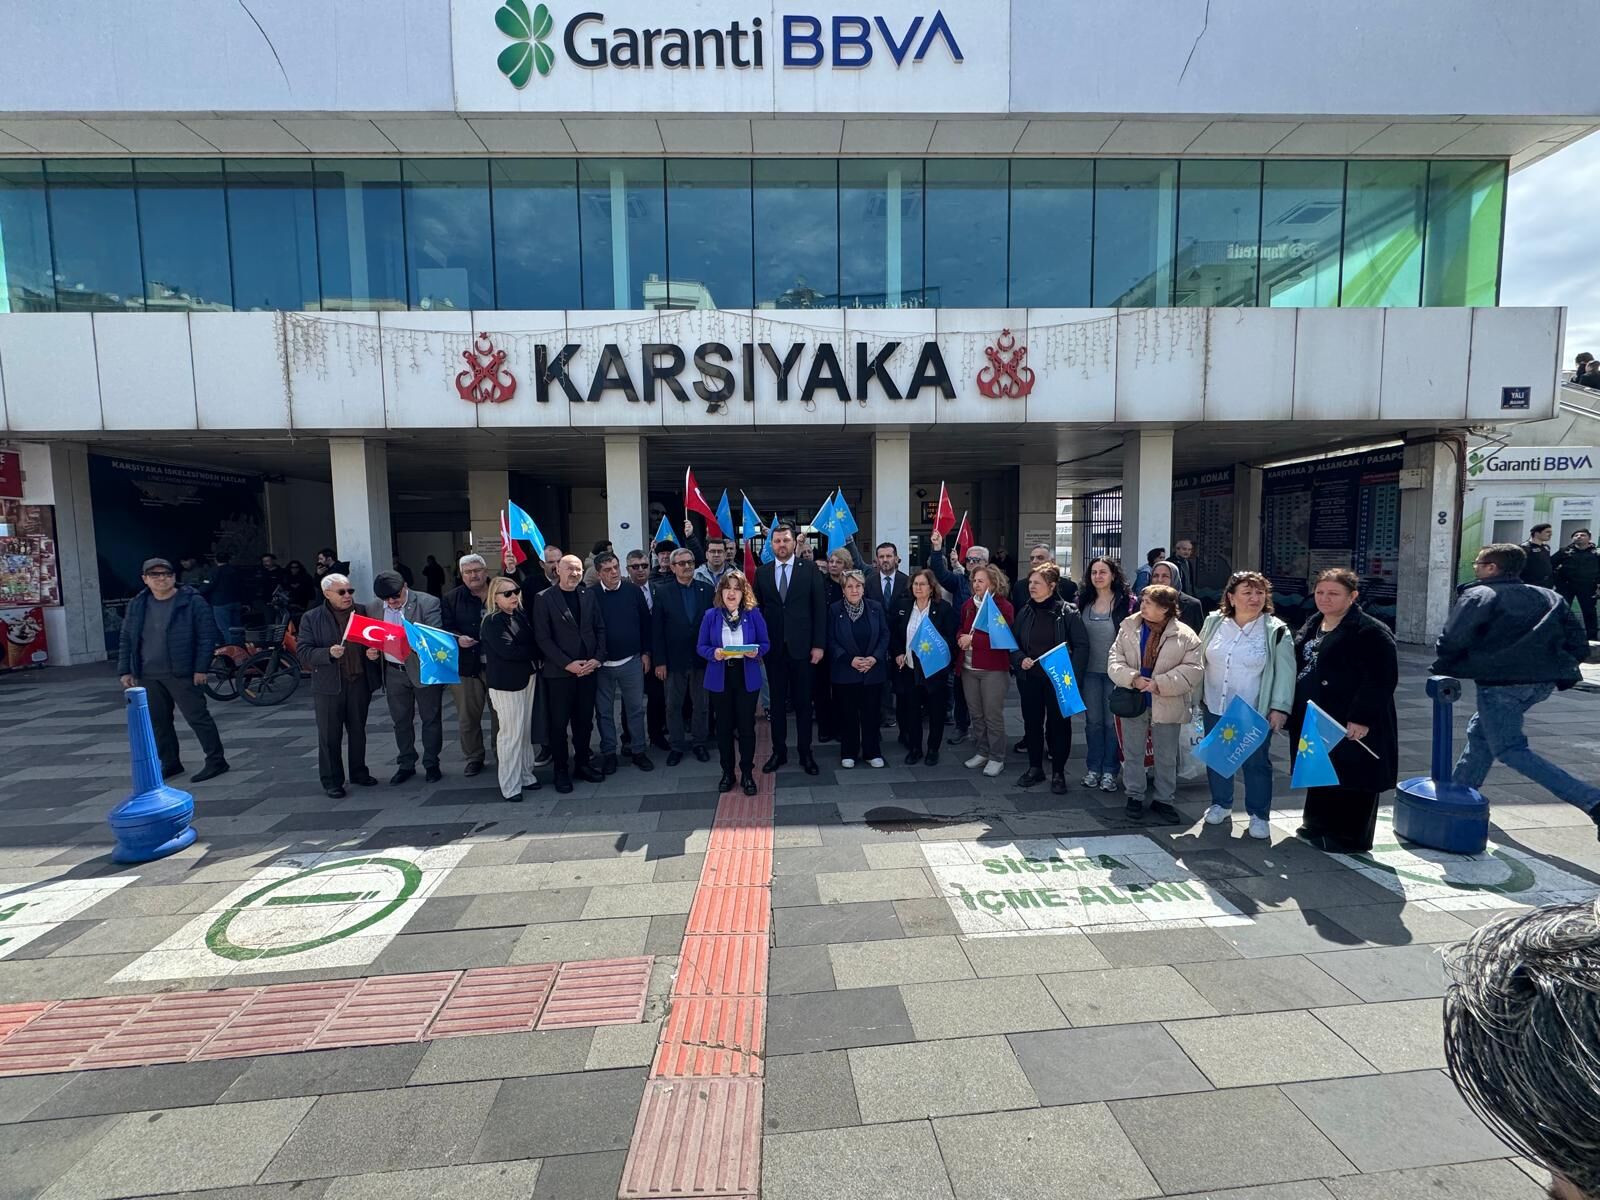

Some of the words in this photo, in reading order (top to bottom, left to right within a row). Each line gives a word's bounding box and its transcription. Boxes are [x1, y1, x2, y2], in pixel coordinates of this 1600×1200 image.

[563, 12, 764, 69] Garanti
[782, 9, 964, 68] BBVA
[534, 341, 958, 413] KARŞIYAKA
[1486, 456, 1541, 472] Garanti
[1543, 454, 1593, 471] BBVA
[1201, 470, 1230, 483] KONAK
[981, 853, 1129, 875] SİGARA
[1075, 882, 1206, 906] ALANI
